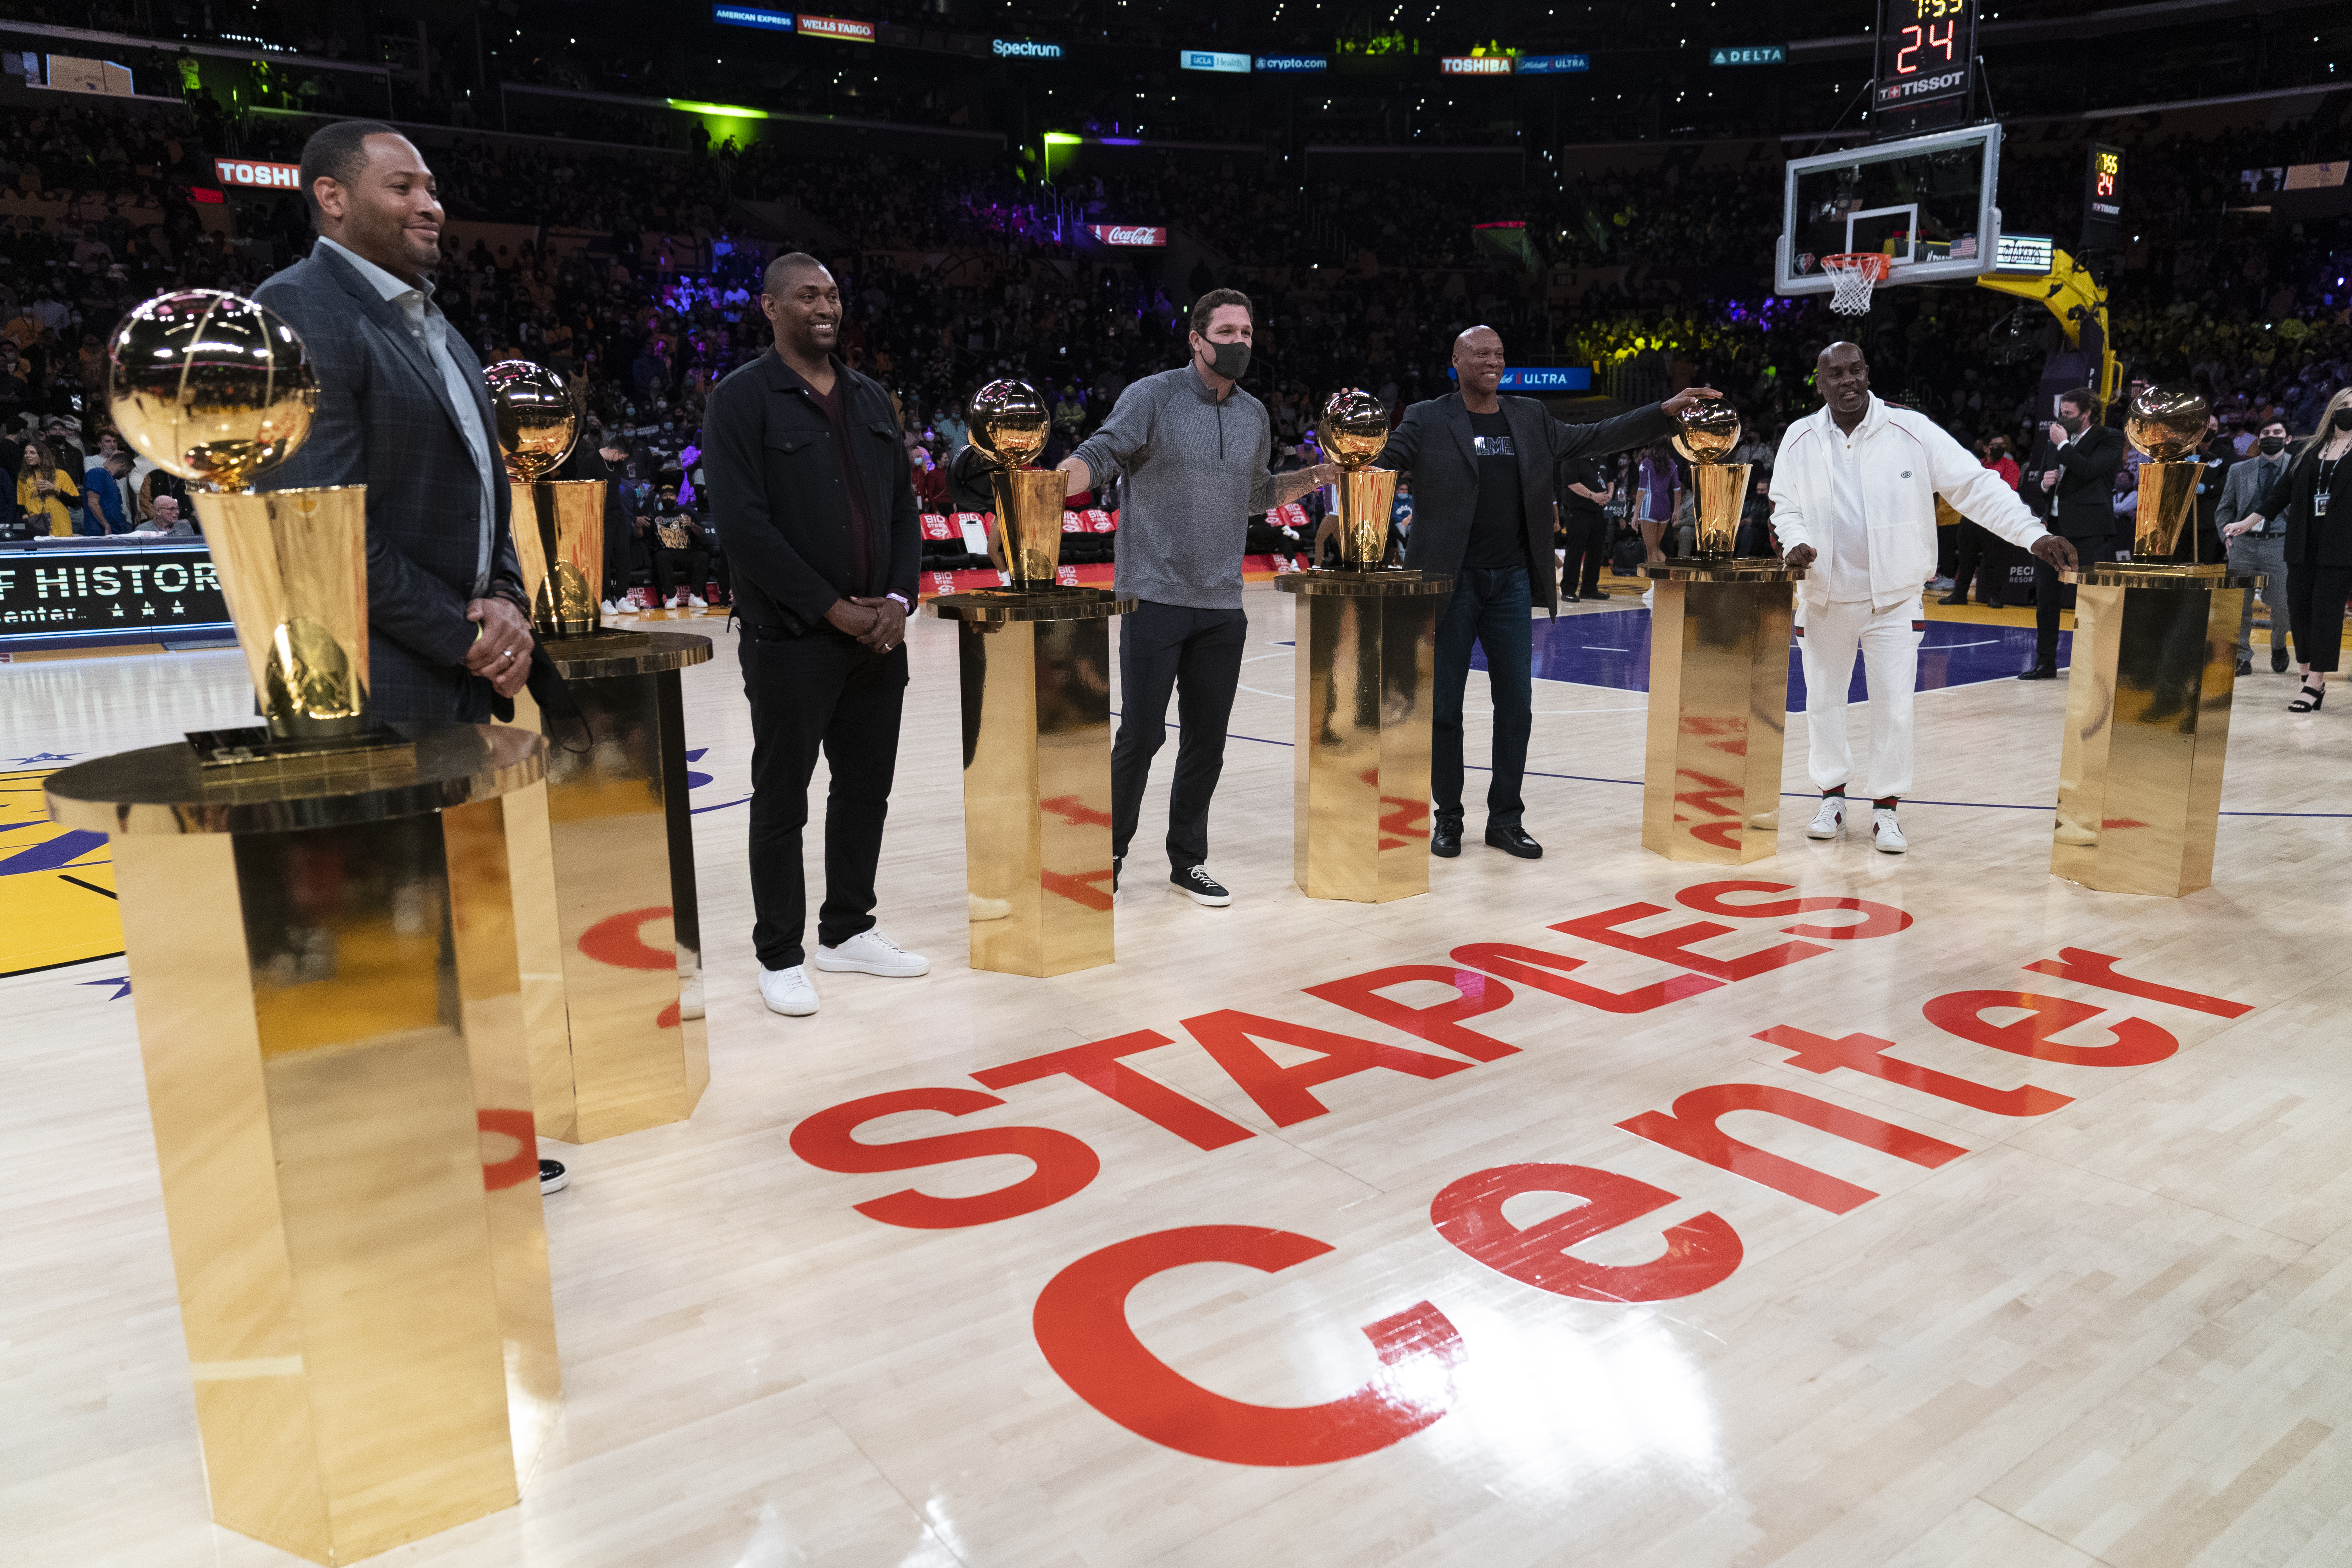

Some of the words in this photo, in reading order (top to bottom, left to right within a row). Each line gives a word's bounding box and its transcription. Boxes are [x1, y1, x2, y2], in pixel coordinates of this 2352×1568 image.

[716, 9, 756, 21] AMERICAN
[757, 15, 791, 26] EXPRESS
[802, 18, 836, 31] WELLS
[838, 23, 870, 36] FARGO
[993, 39, 1060, 58] Spectrum
[1730, 49, 1782, 62] DELTA
[1897, 19, 1954, 74] 24
[1267, 58, 1327, 70] crypto.com
[1442, 58, 1510, 72] TOSHIBA
[1555, 58, 1585, 68] ULTRA
[1902, 71, 1965, 96] TISSOT
[218, 162, 299, 187] TOSHI
[2098, 172, 2113, 196] 24
[1108, 226, 1157, 245] Coca-Cola
[1524, 373, 1567, 384] ULTRA
[35, 562, 222, 598] HISTOR
[933, 572, 953, 581] BIO
[789, 879, 1913, 1230] STAPLES
[1033, 946, 2256, 1466] Center
